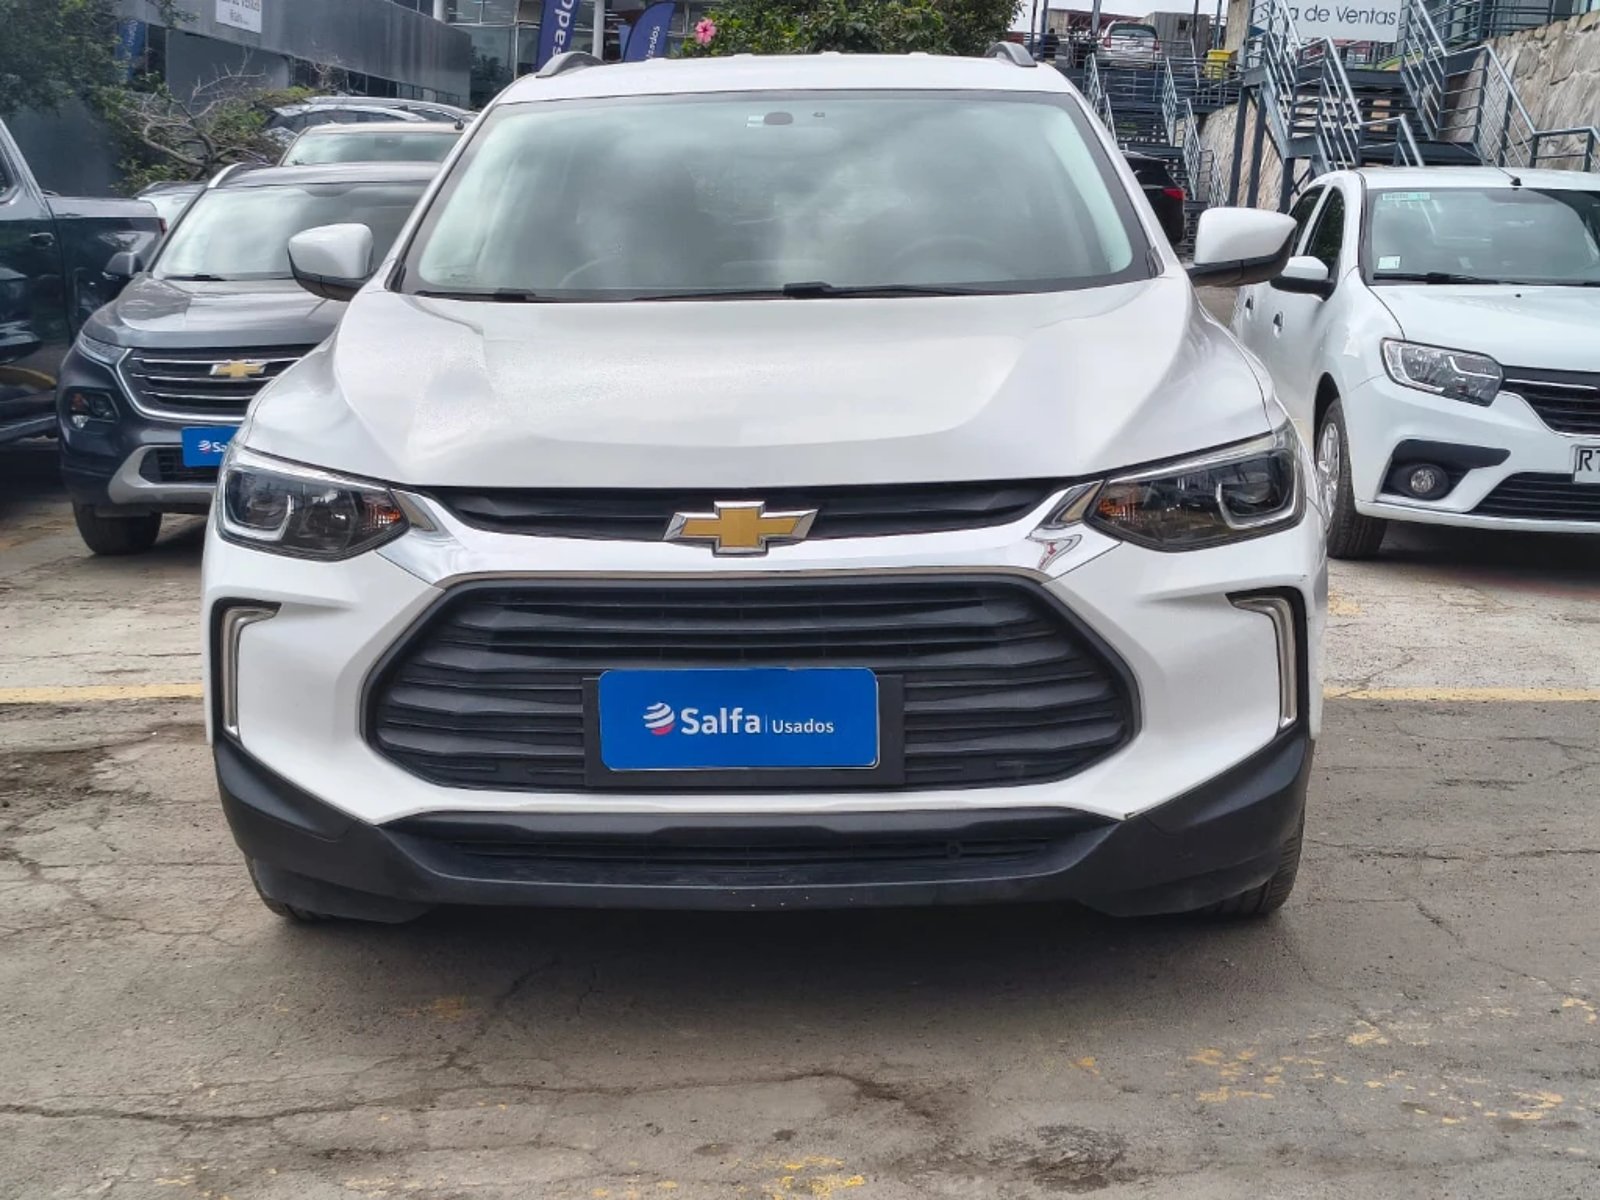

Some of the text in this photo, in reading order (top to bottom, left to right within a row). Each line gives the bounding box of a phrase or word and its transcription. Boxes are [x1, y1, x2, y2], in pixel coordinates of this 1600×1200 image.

[1304, 5, 1330, 22] de
[1336, 6, 1396, 25] Ventas
[680, 707, 834, 735] Salfa Usados
